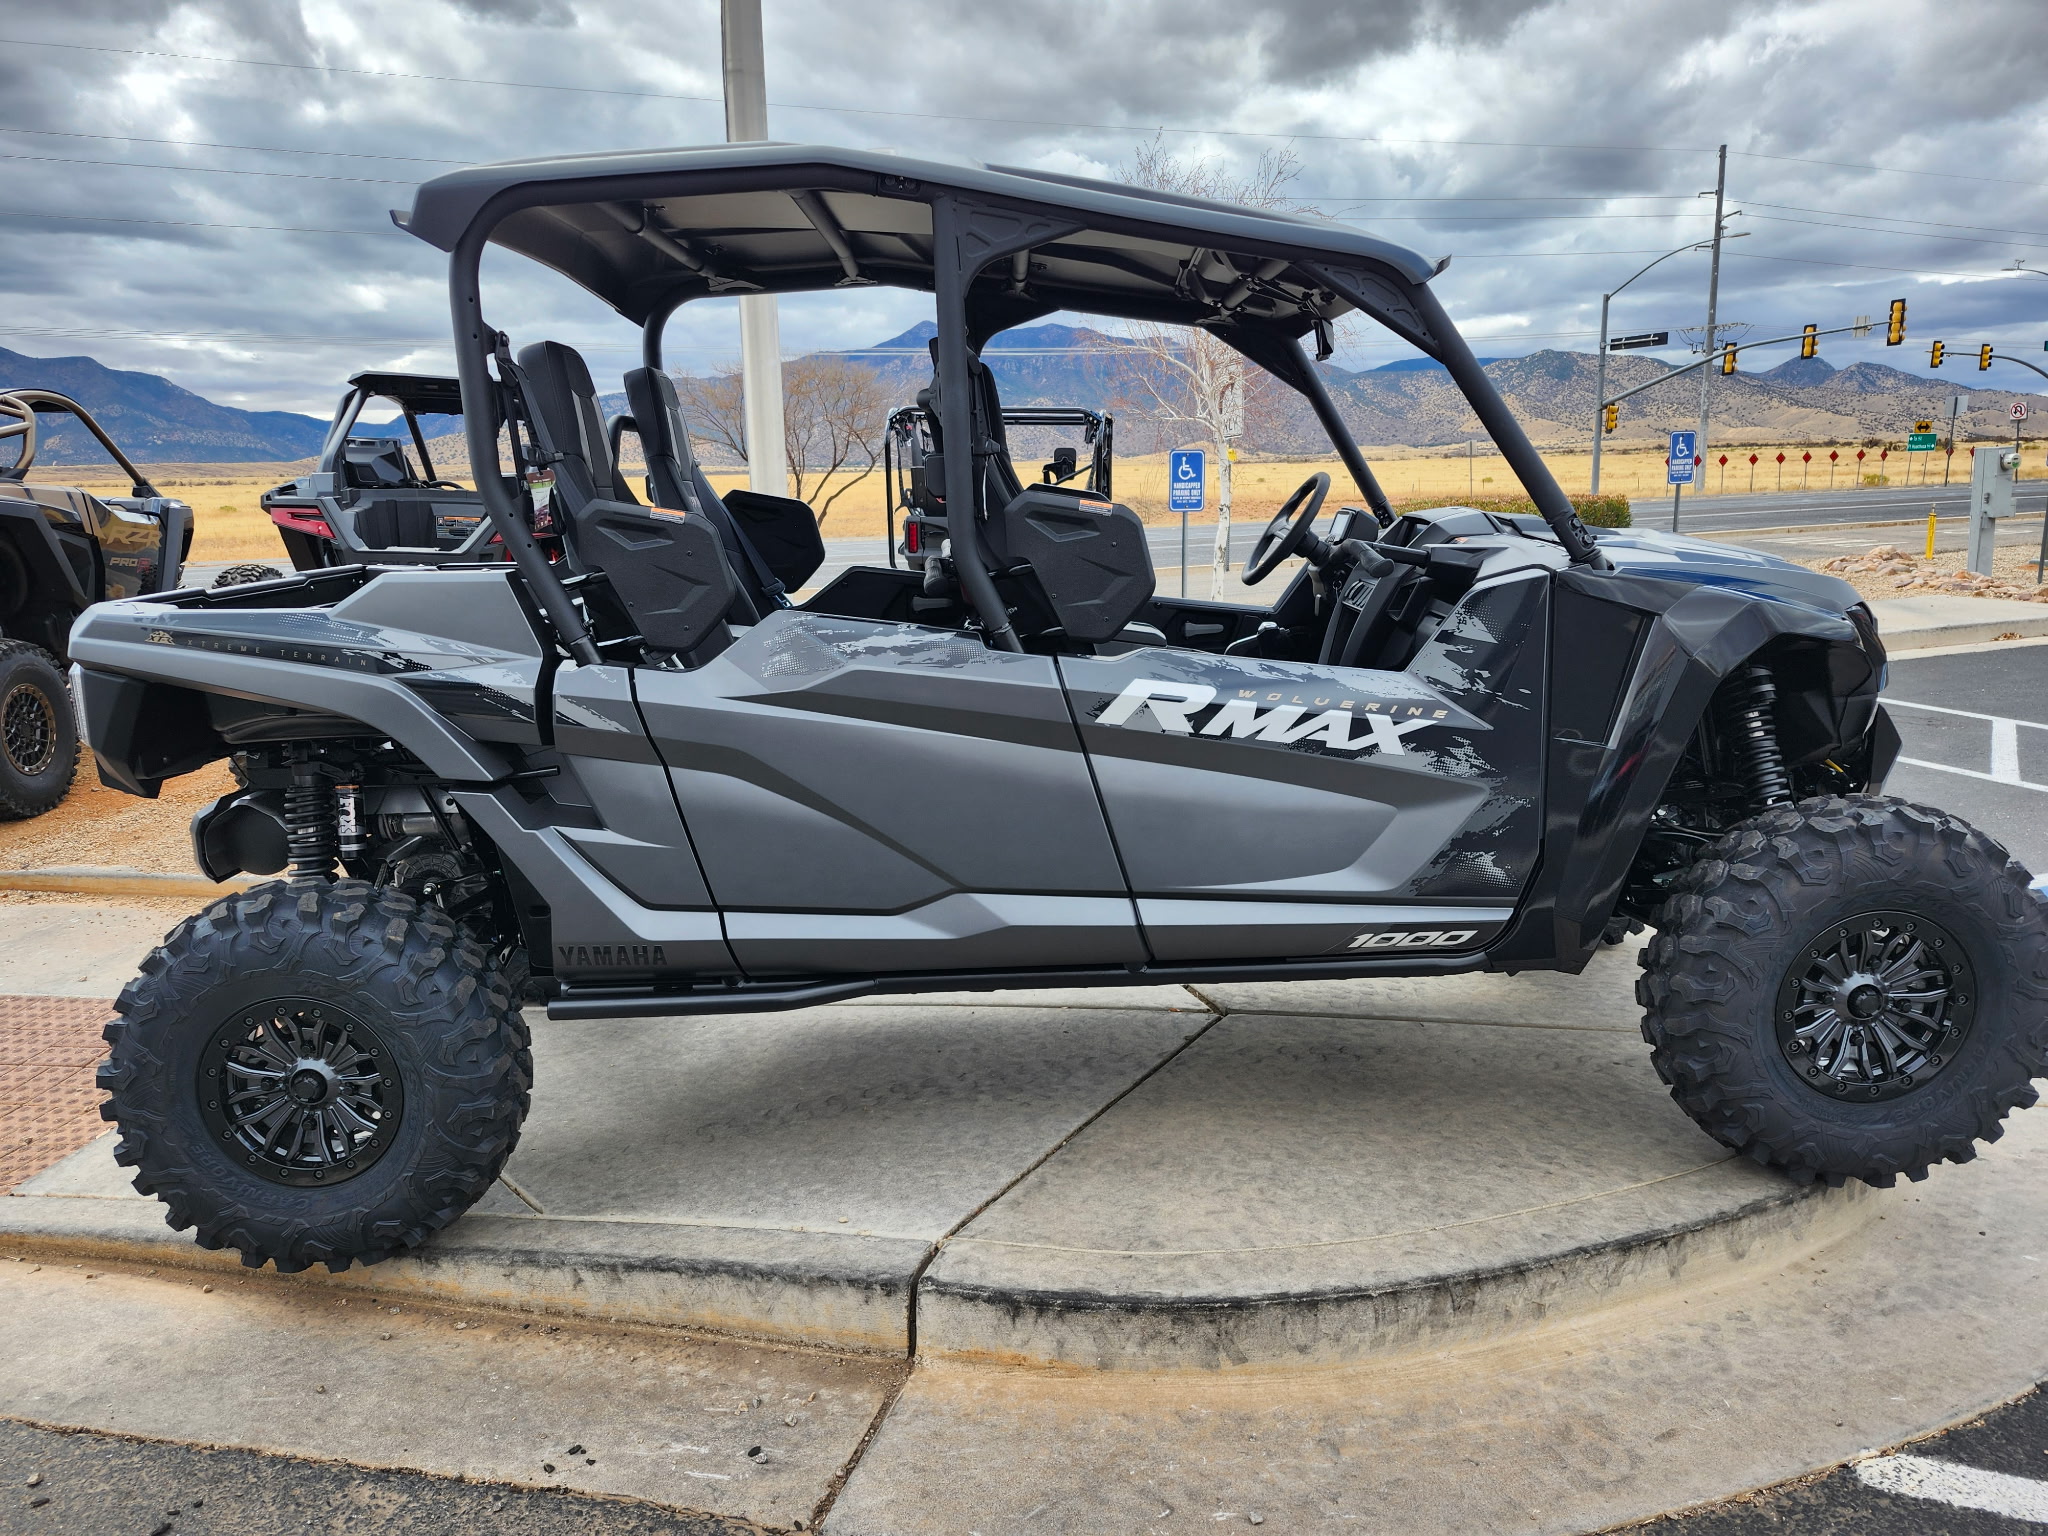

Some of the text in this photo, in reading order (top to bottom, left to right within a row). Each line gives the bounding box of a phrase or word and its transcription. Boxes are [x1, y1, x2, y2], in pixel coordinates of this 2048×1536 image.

[106, 526, 163, 548] RZR
[187, 638, 367, 667] XTREME TERRAIN
[1347, 929, 1479, 949] 1000
[558, 945, 668, 966] YAMAHA
